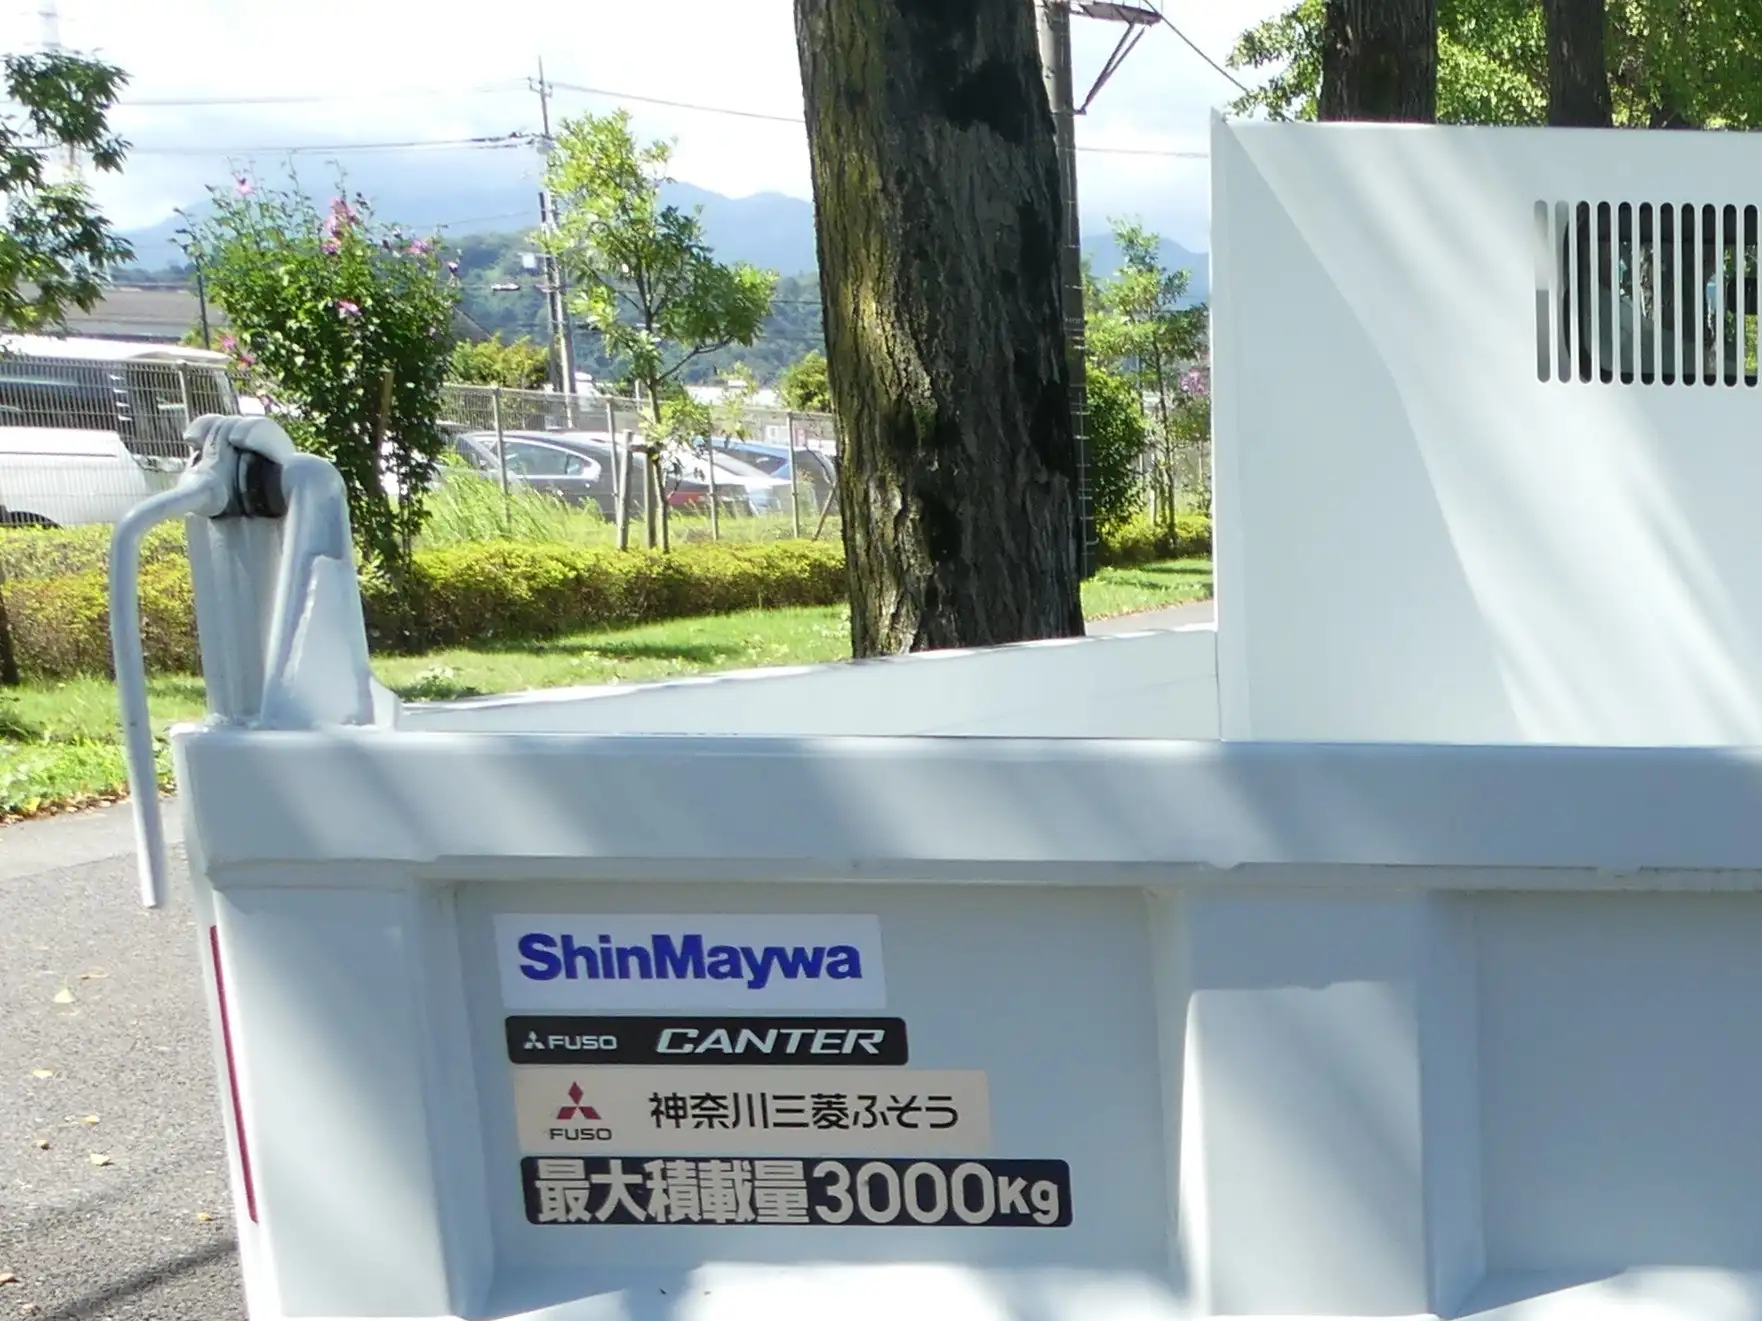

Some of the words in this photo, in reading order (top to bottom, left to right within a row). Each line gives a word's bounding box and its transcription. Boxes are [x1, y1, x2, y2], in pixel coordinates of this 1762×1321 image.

[517, 932, 862, 990] ShinMaywa
[548, 1035, 618, 1050] FUSO
[655, 1028, 885, 1055] CANTER
[649, 1092, 959, 1130] 神奈川三菱ふそう
[549, 1127, 612, 1141] FUSO
